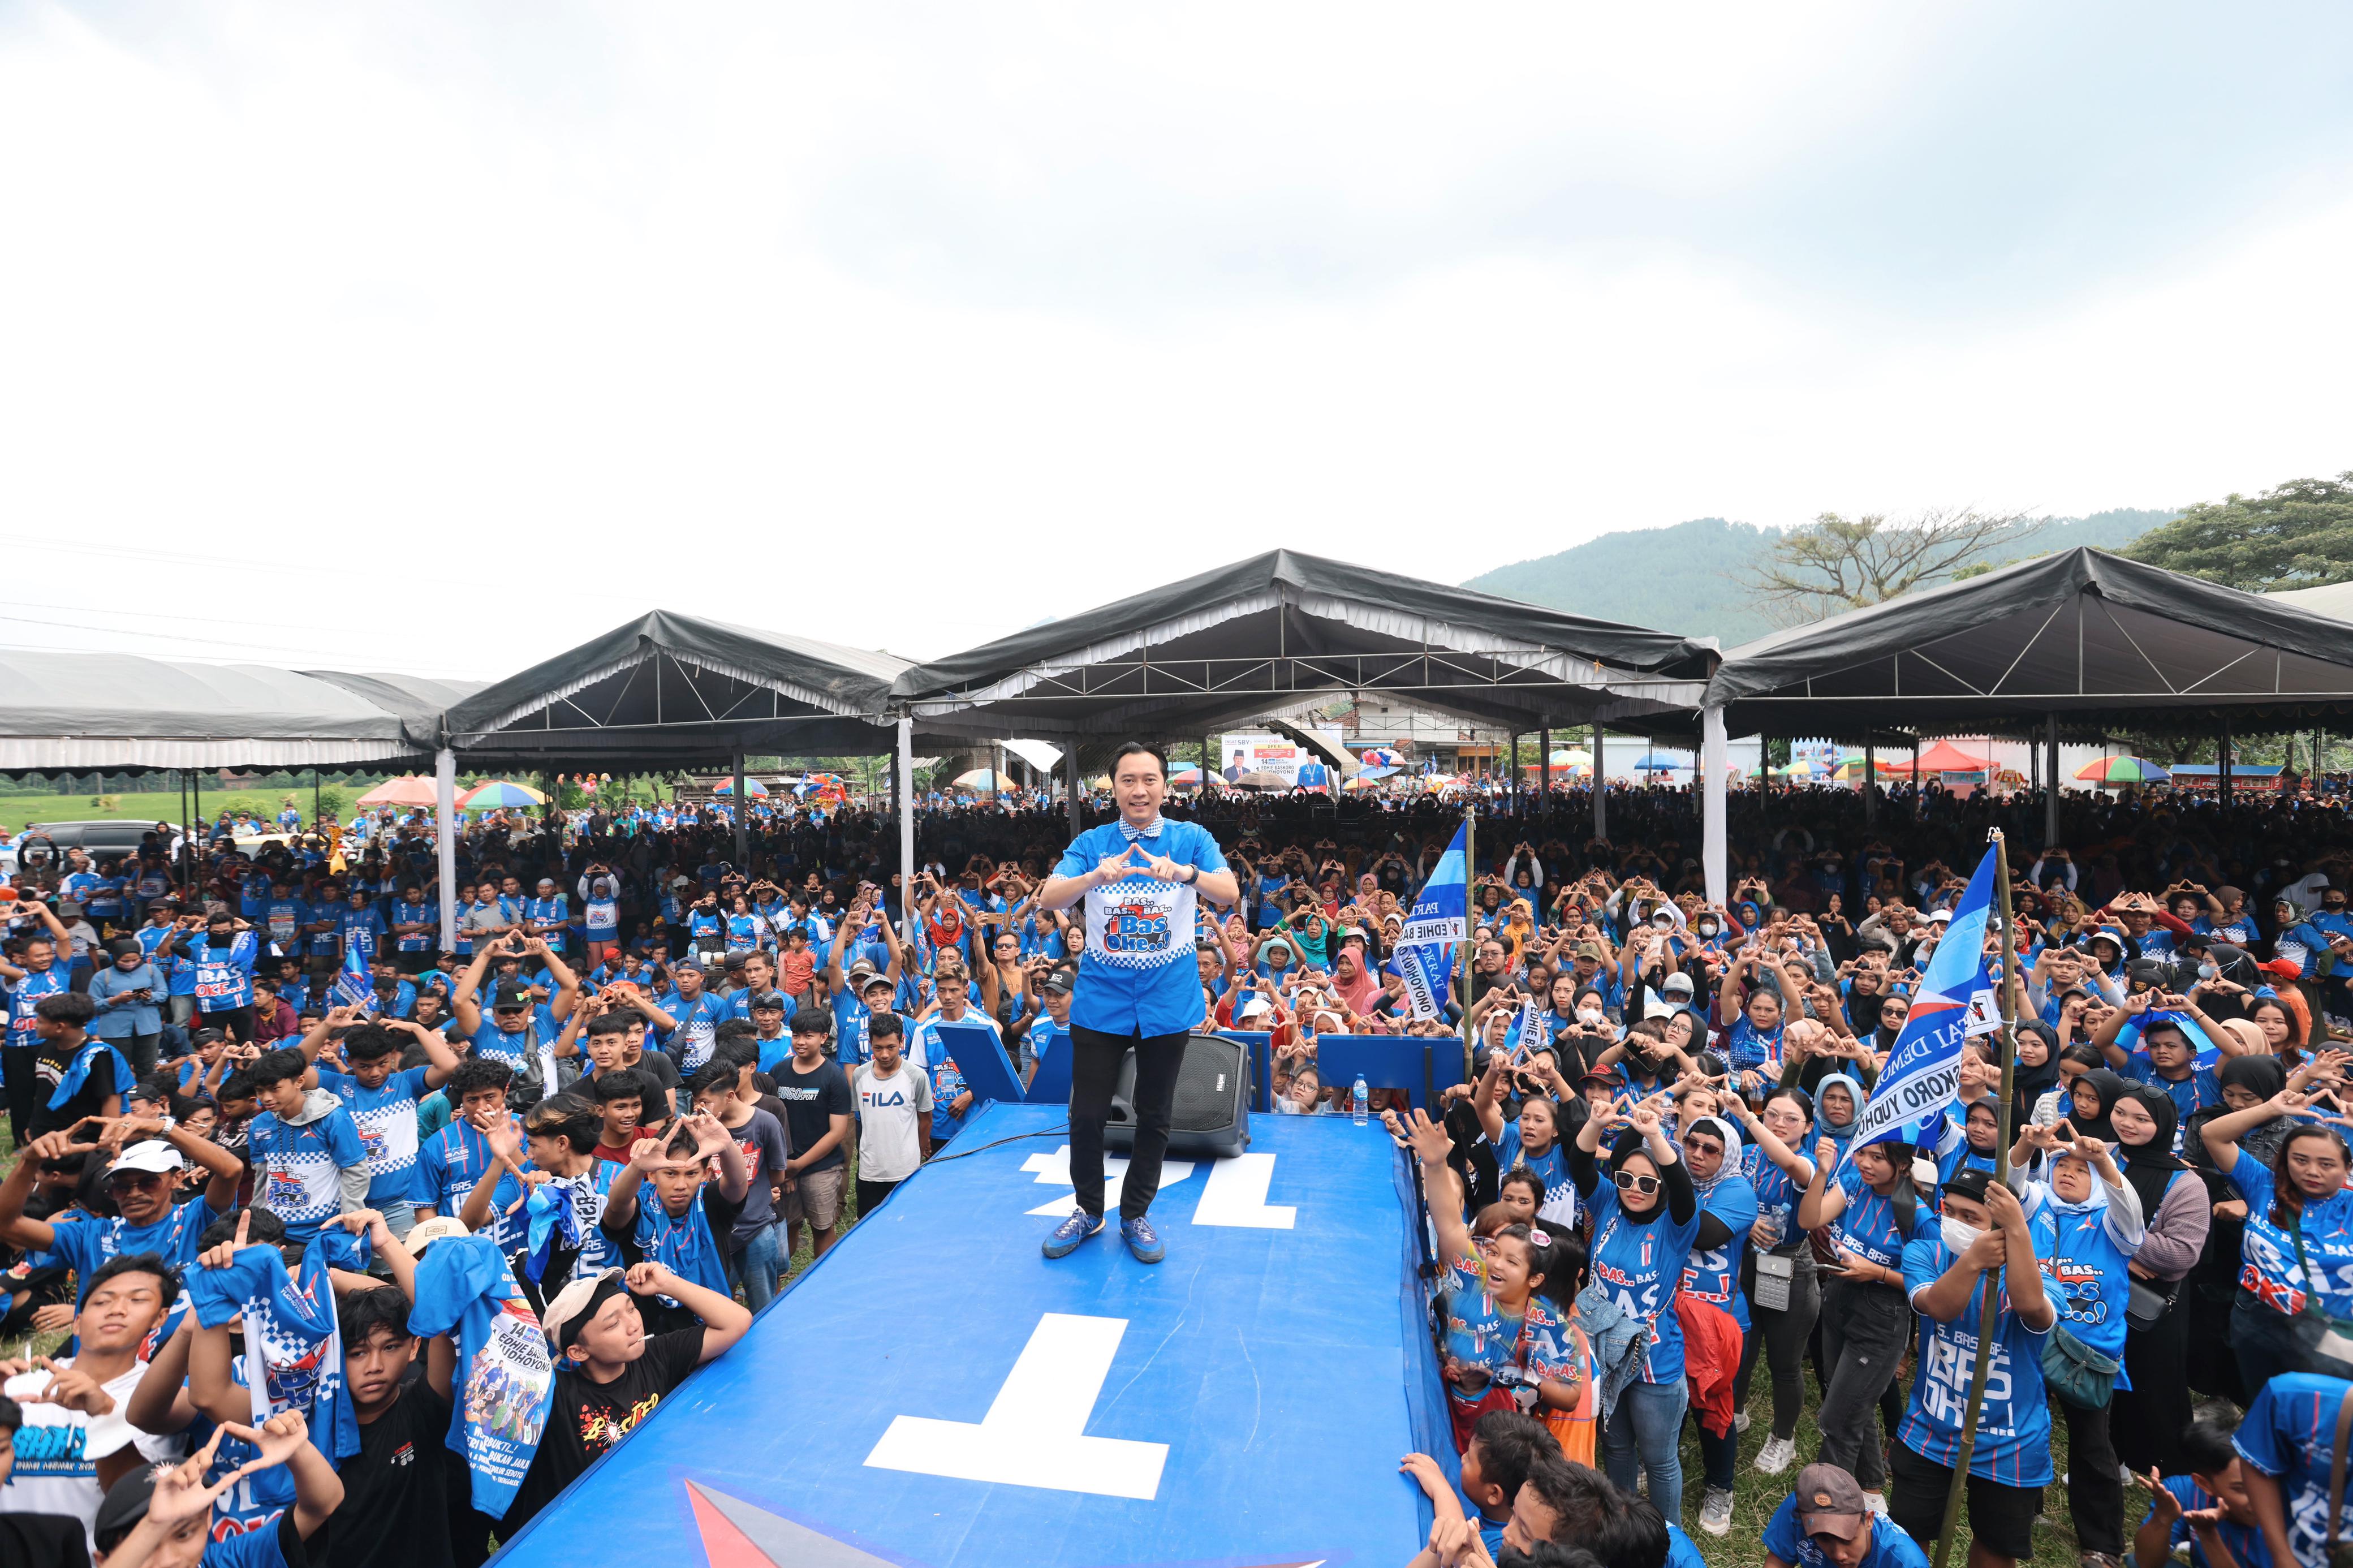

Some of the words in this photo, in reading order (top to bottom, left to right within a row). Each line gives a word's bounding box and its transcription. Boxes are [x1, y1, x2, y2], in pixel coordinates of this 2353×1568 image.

[1105, 907, 1135, 915] BAS..
[1143, 905, 1172, 915] BAS..
[1123, 897, 1154, 906] BAS..
[1109, 915, 1168, 935] iBas
[1402, 956, 1432, 1013] YUDHOYONO
[1527, 1007, 1539, 1037] EDHIE
[777, 1086, 802, 1100] HUGO
[862, 1091, 905, 1108] FILA
[1842, 1233, 1866, 1256] BAS..
[1867, 1247, 1894, 1267] BAS..
[1598, 1261, 1635, 1287] BAS..
[510, 1322, 527, 1338] 14
[498, 1333, 528, 1355] EDHIE
[488, 1450, 514, 1466] BUKAN
[511, 1458, 531, 1470] JANJI
[505, 1469, 524, 1479] SEDOYO
